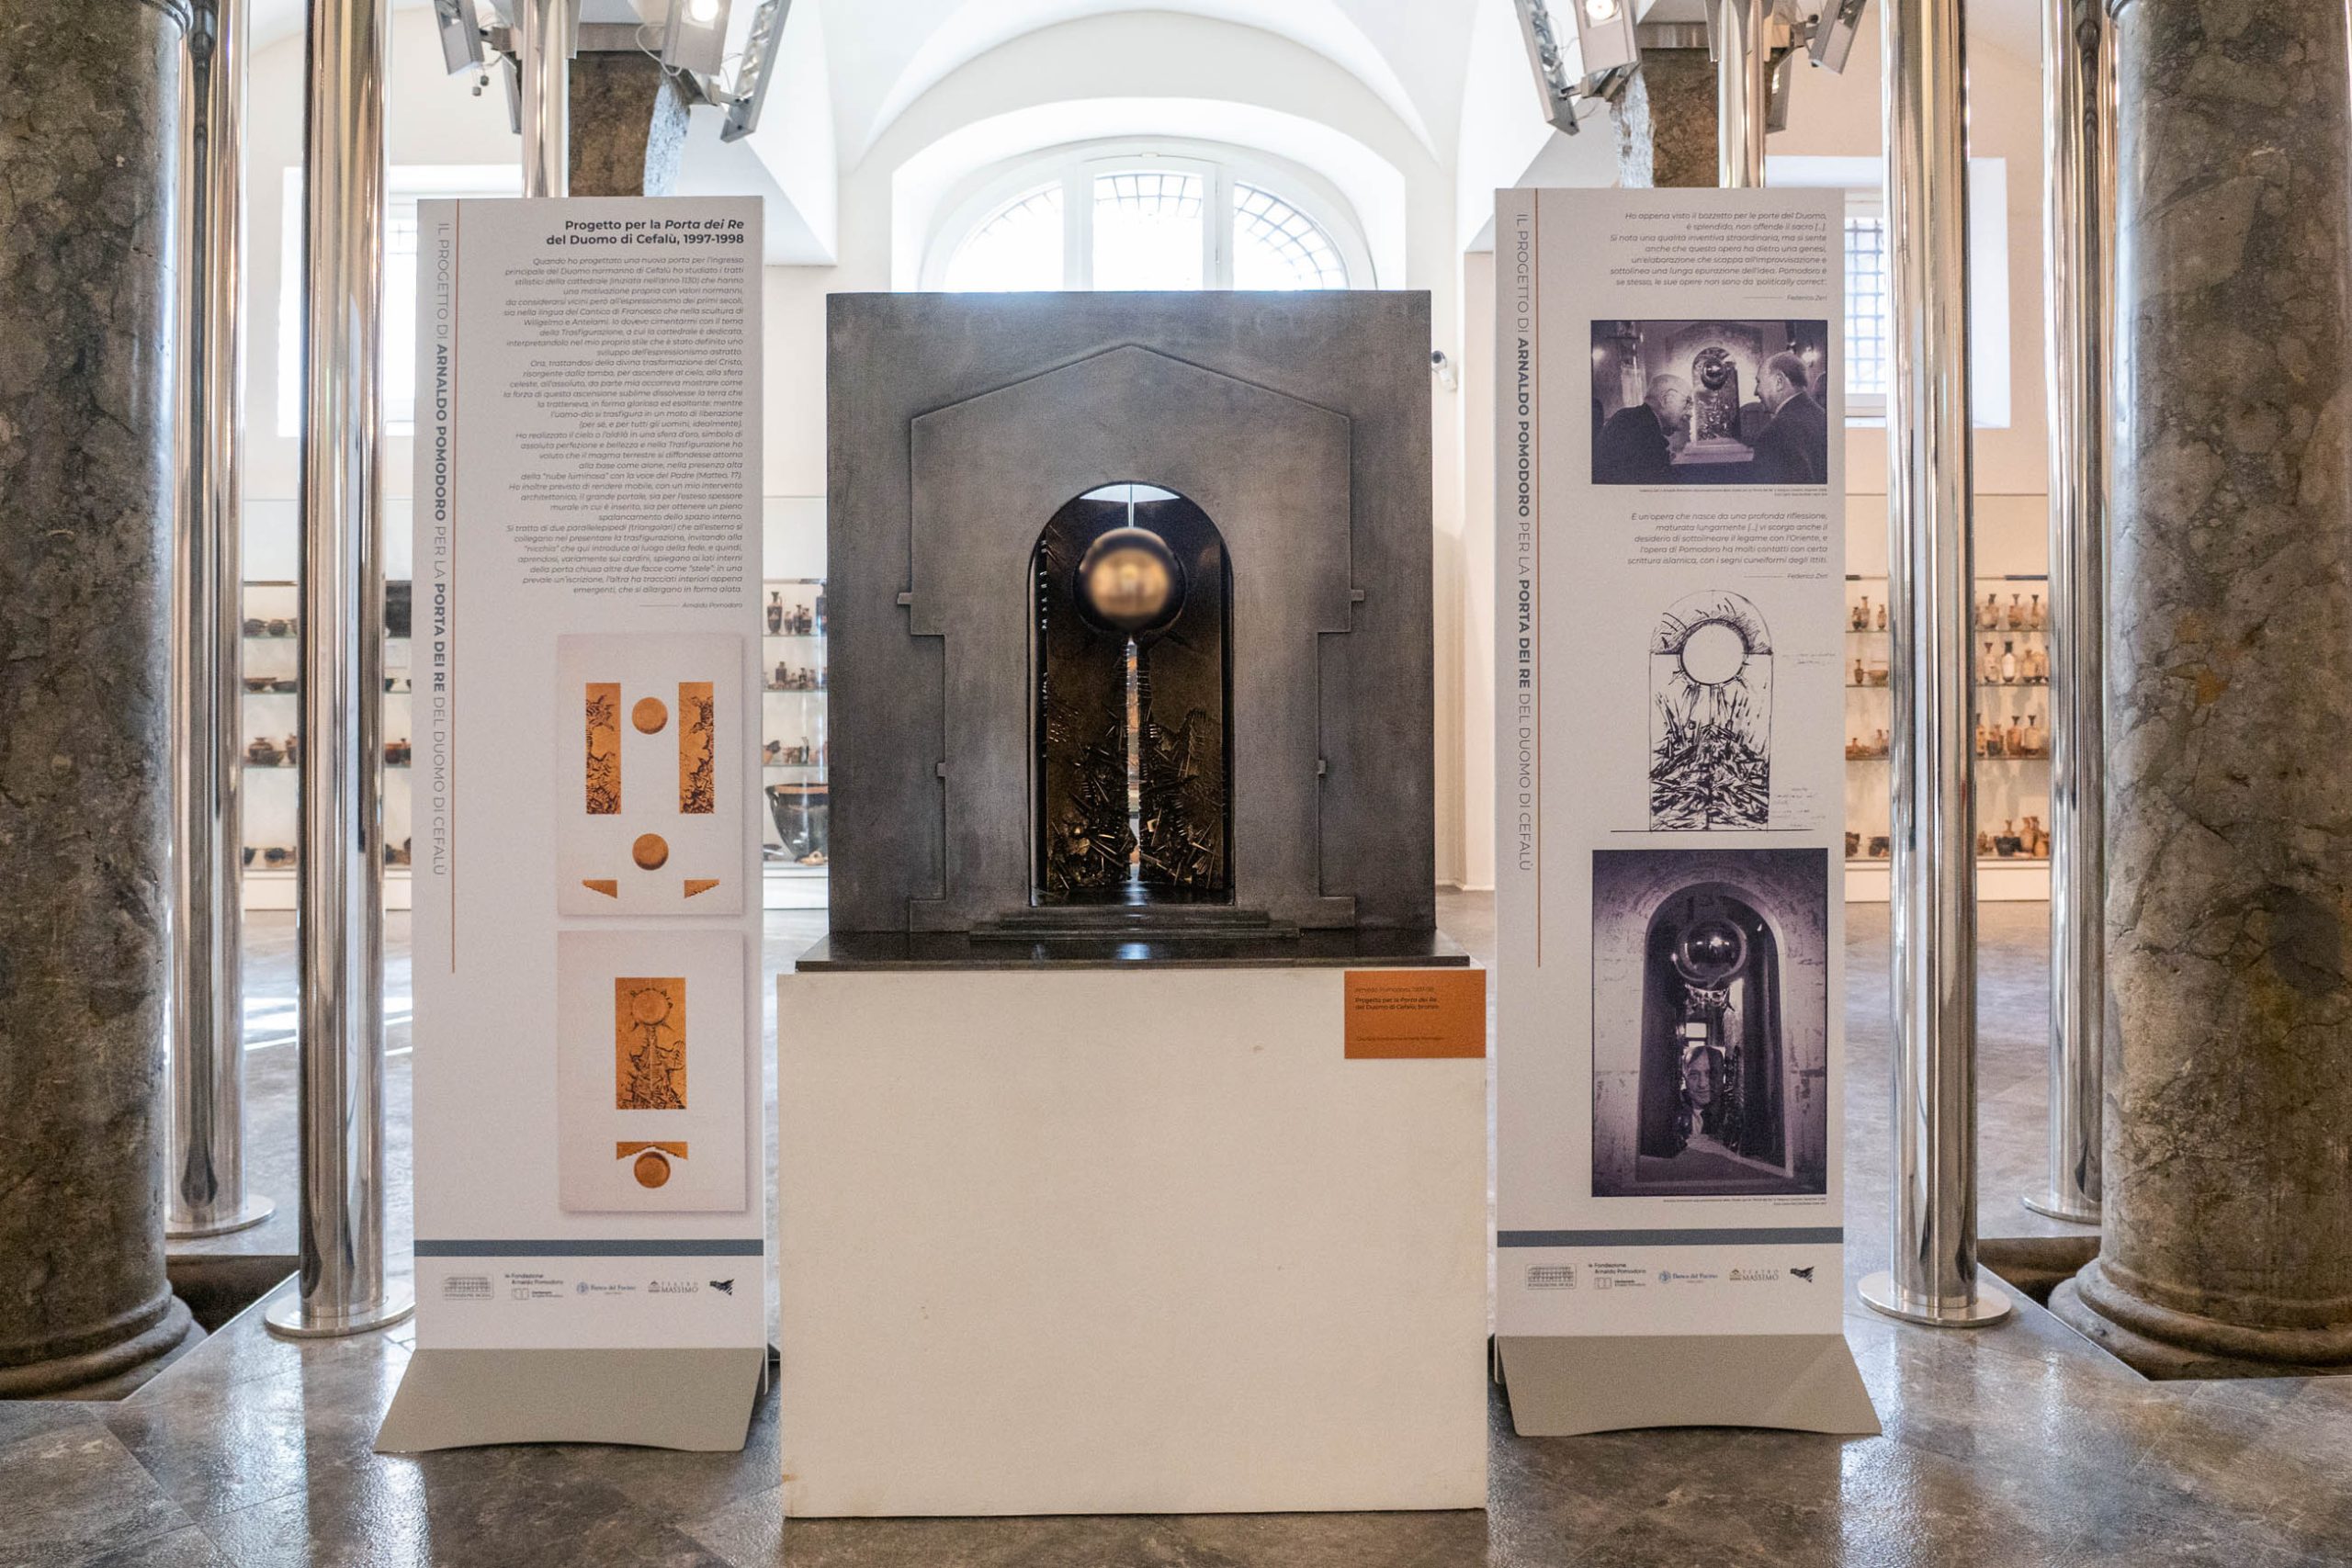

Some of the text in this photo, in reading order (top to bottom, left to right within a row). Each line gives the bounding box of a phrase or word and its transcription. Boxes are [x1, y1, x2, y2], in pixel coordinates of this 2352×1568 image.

[565, 219, 744, 232] Progetto per la Porta dei Re
[547, 233, 744, 246] del Duomo di Cefalù, 1997-1998
[1657, 234, 1686, 243] qualità
[1689, 245, 1716, 254] questa
[533, 257, 566, 265] Quando
[579, 257, 622, 265] progettato
[504, 267, 545, 276] principale
[1669, 267, 1693, 276] lunga
[1695, 267, 1740, 276] epurazione
[1747, 513, 1785, 521] profonda
[1696, 524, 1746, 532] lungamente
[1518, 214, 1533, 870] IL PROGETTO DI ARNALDO POMODORO PER LA PORTA DEI RE DEL DUOMO DI CEFALÙ
[433, 223, 448, 875] IL PROGETTO DI ARNALDO POMODORO PER LA PORTA DEI RE DEL DUOMO DI CEFALÙ
[1720, 557, 1742, 565] segni
[1788, 556, 1808, 565] degli
